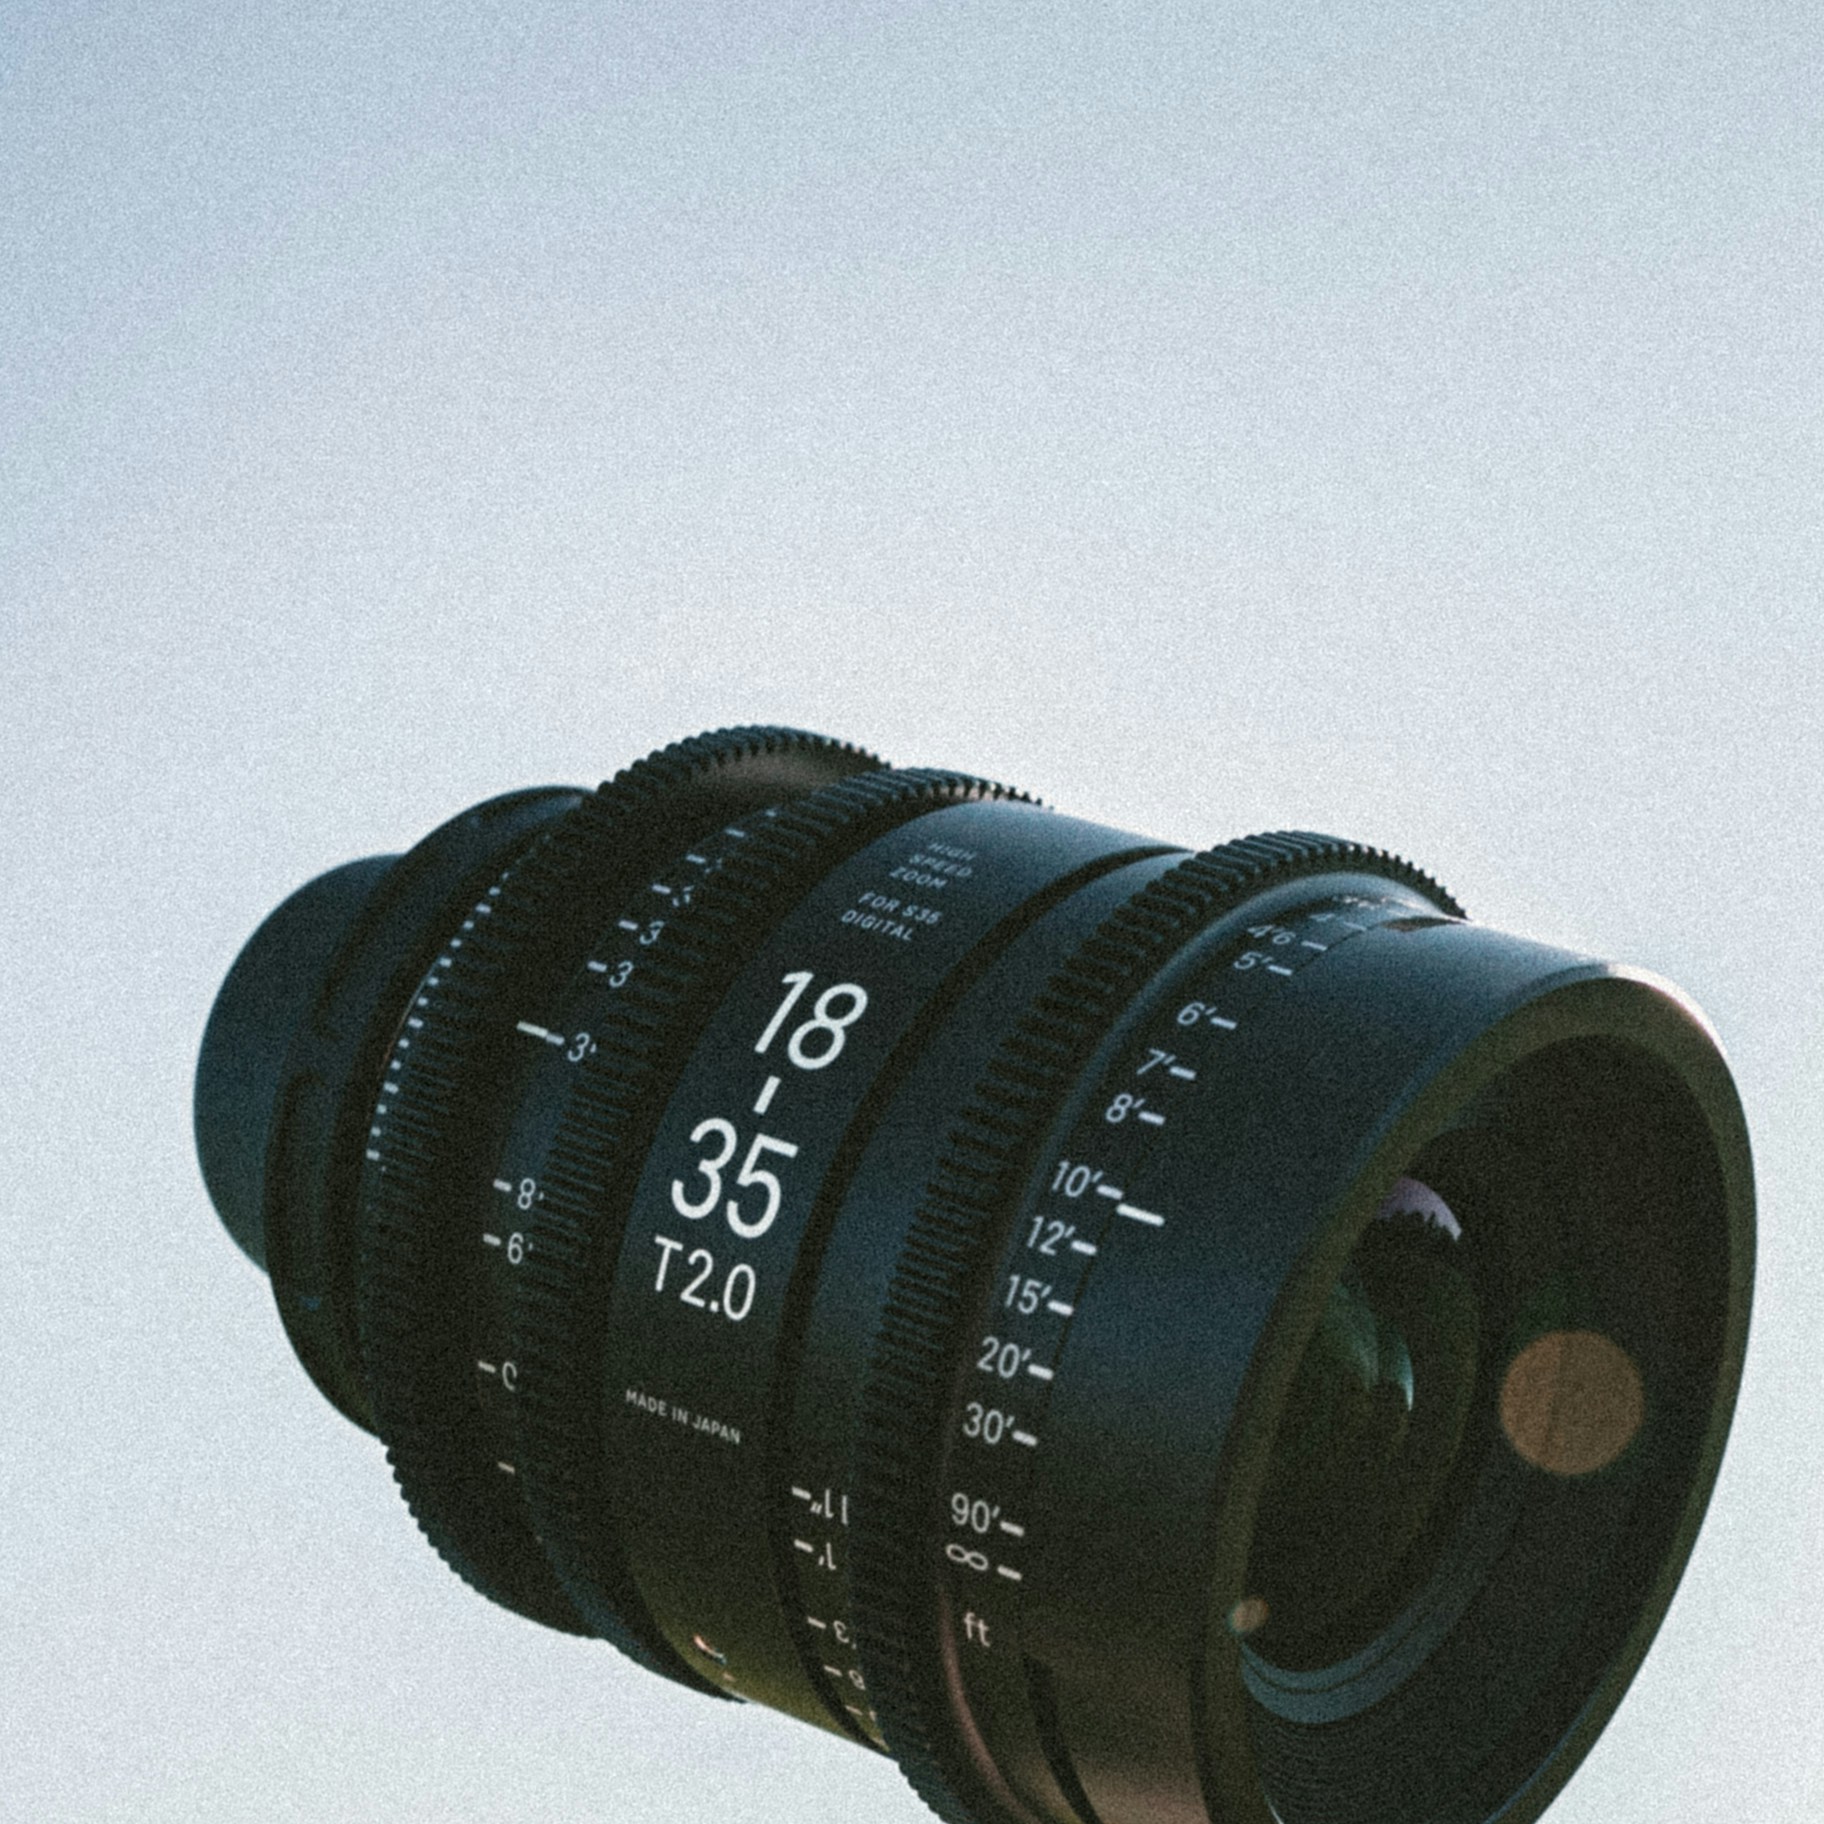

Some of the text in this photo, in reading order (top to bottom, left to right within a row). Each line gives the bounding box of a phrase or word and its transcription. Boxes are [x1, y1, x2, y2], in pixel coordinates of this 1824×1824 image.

[889, 866, 948, 889] ZOOM
[909, 854, 973, 877] SPEED
[841, 909, 914, 941] DIGITAL
[858, 890, 942, 925] FOR S35
[1233, 952, 1274, 970] 5'
[754, 970, 868, 1070] 18
[1177, 1002, 1218, 1026] 6'
[1136, 1049, 1176, 1075] 7'
[1105, 1093, 1145, 1123] 8'
[671, 1117, 799, 1239] 35
[1051, 1160, 1104, 1198] 10'
[1027, 1215, 1076, 1256] 12'
[655, 1234, 756, 1321] T2.0
[1005, 1274, 1052, 1315] 15'
[977, 1336, 1032, 1379] 20'
[626, 1388, 742, 1445] MADE IN JAPAN
[963, 1402, 1015, 1445] 30'
[951, 1492, 1000, 1534] 90'
[963, 1611, 991, 1648] ft
